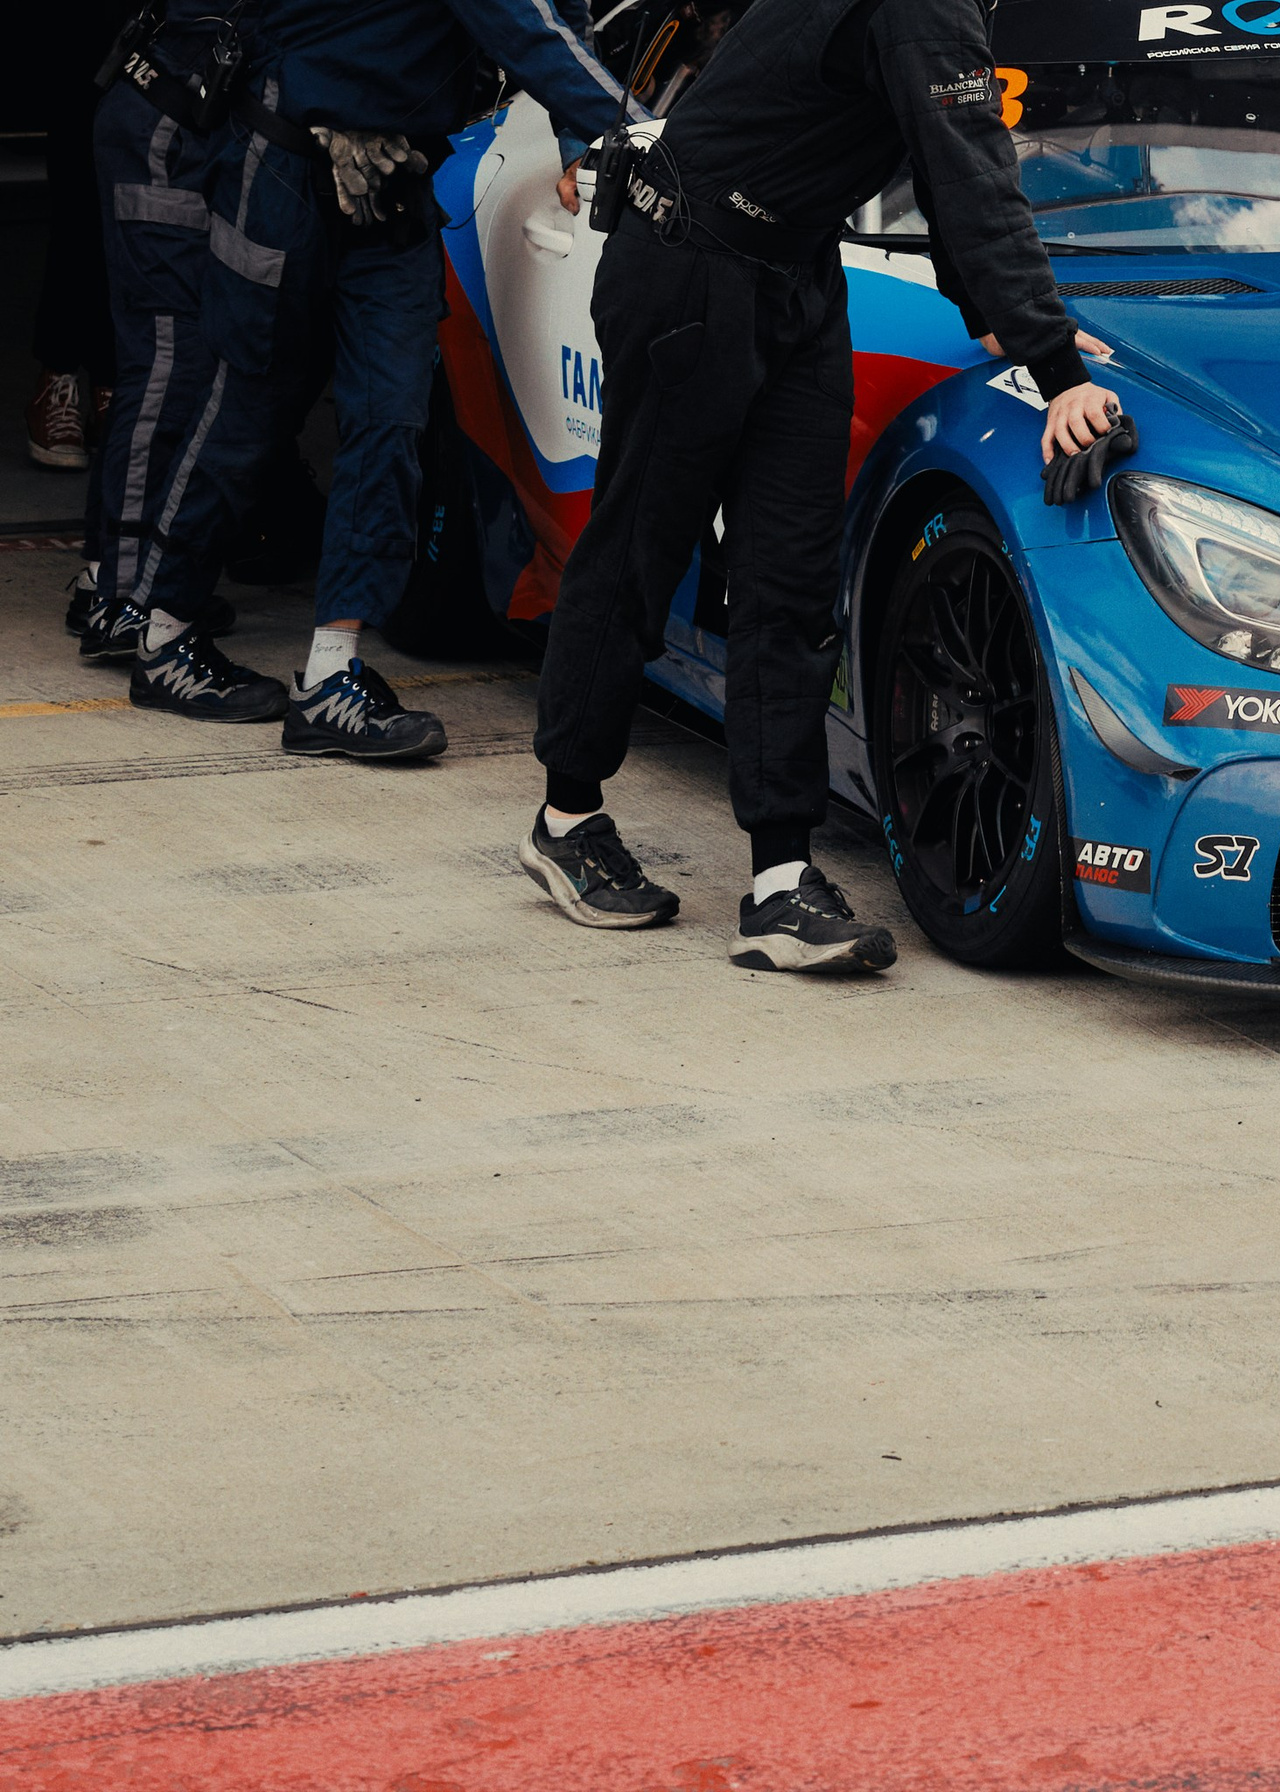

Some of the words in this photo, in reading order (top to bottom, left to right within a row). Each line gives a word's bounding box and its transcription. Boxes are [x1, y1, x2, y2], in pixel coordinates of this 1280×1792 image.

[1147, 46, 1220, 59] РОССИЙСКАЯ
[1223, 43, 1261, 52] СЕРИЯ
[957, 91, 985, 104] SERIES
[923, 512, 948, 547] FR
[1077, 842, 1144, 872] АВТО
[1075, 863, 1120, 884] ПЛЮС
